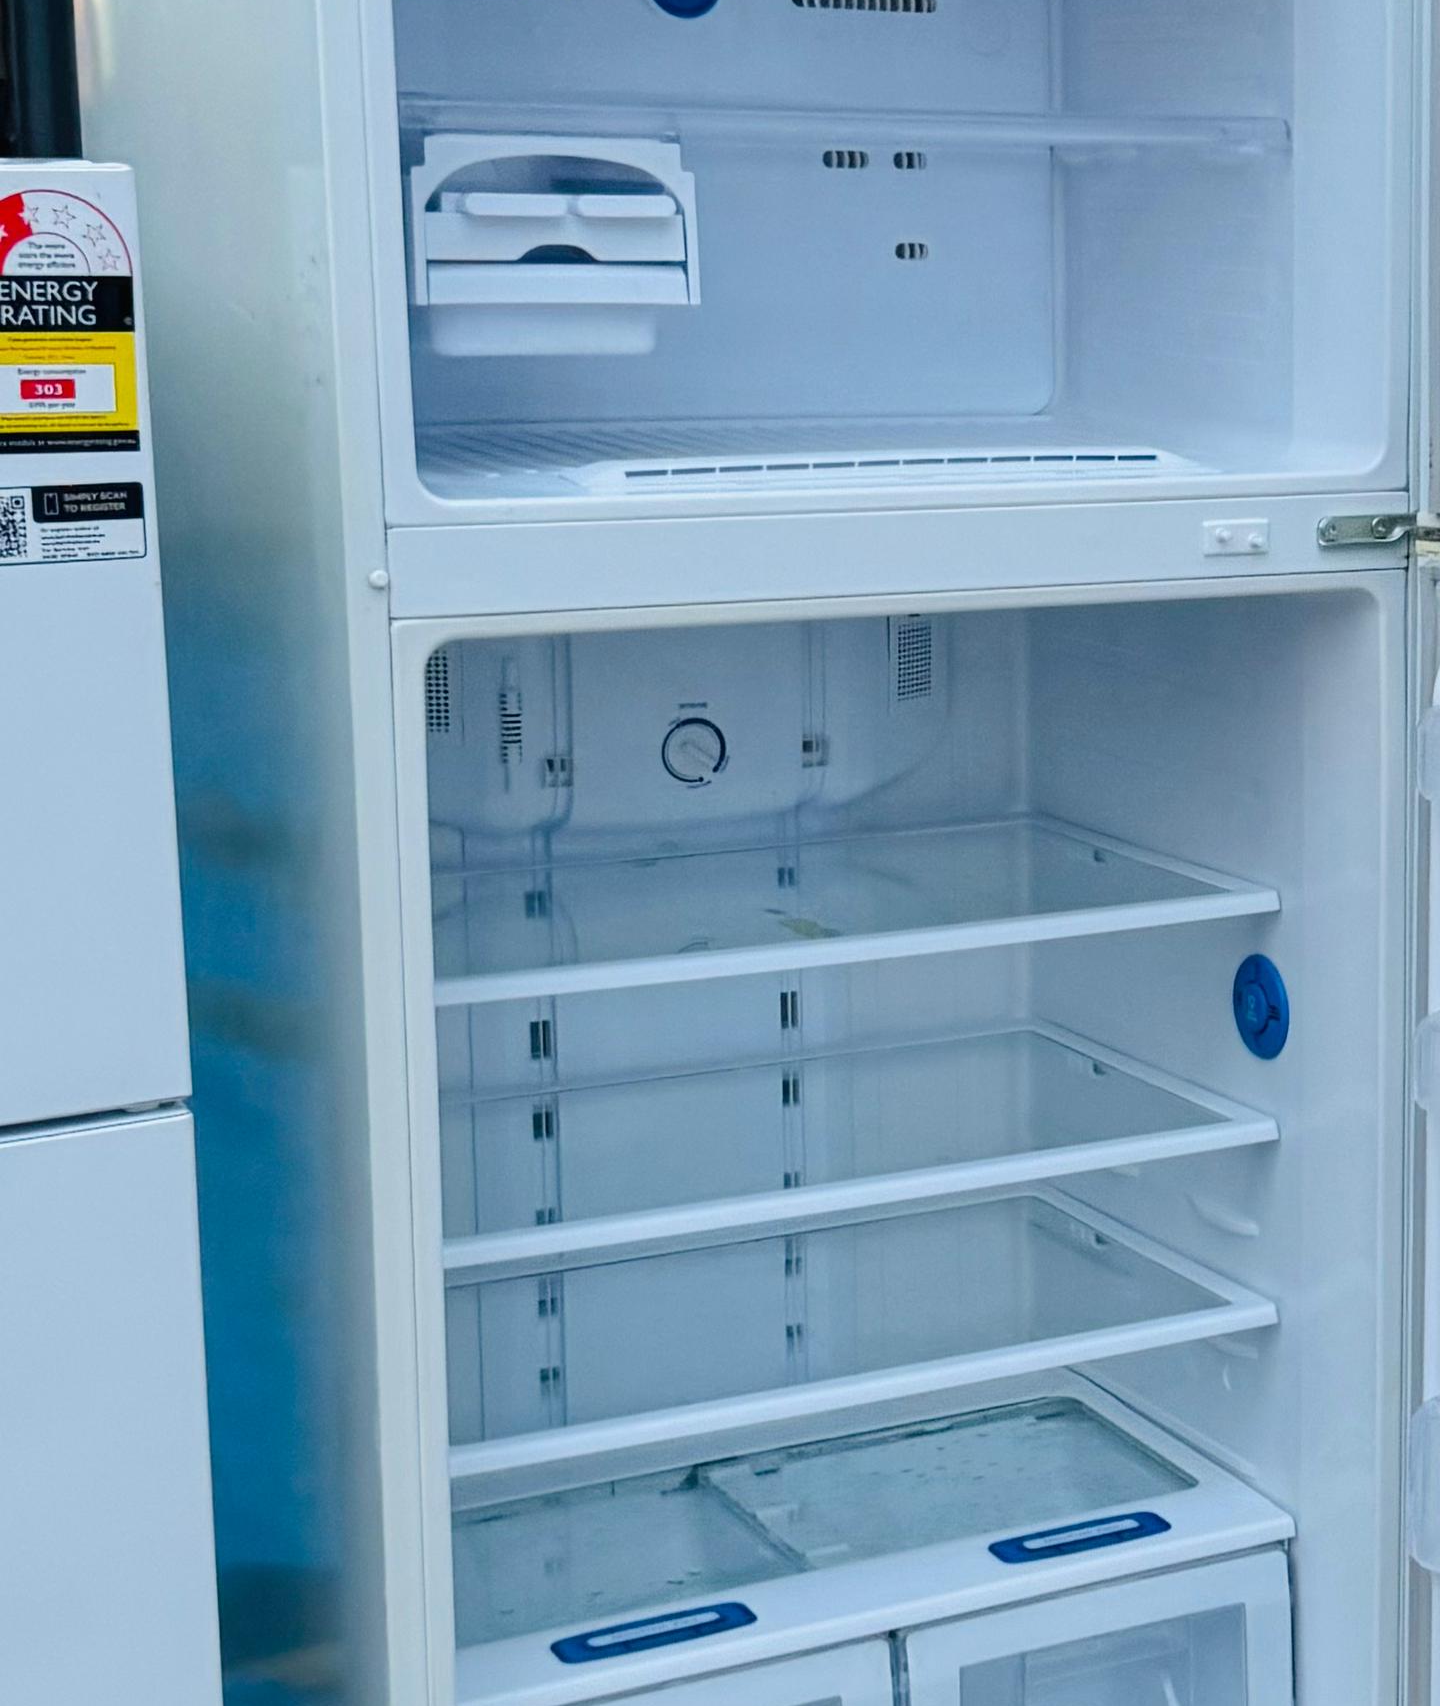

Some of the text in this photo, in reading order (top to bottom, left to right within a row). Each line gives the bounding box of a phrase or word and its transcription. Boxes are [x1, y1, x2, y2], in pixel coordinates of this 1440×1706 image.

[0, 280, 98, 302] ENERGY
[1, 304, 97, 326] RATING
[34, 383, 63, 396] 303
[100, 490, 128, 500] SCAN
[63, 501, 126, 513] TO REGISTER
